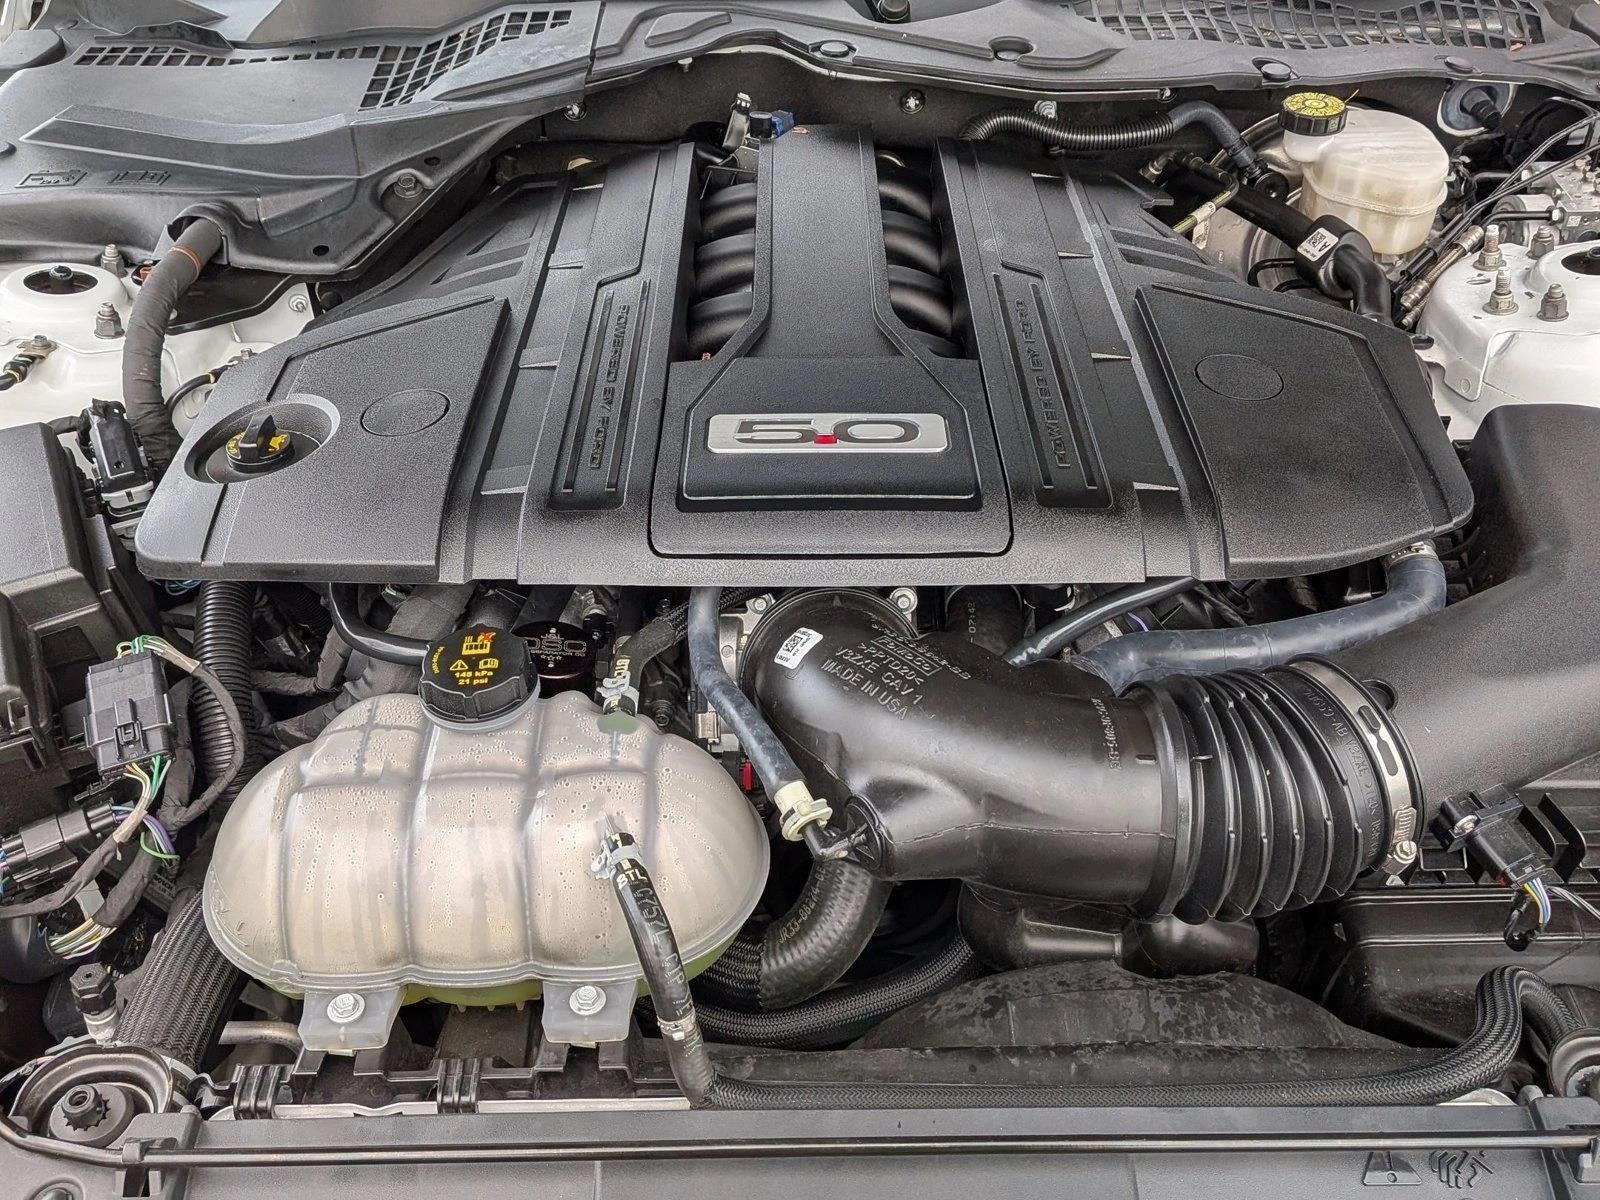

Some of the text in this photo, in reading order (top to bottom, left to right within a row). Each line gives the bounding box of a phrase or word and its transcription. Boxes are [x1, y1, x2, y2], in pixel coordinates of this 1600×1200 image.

[589, 304, 630, 470] POWERED BY FORD
[1015, 298, 1071, 467] POWERED BY FORD
[734, 418, 921, 444] 5.0
[454, 670, 494, 679] 145 kPa
[473, 677, 489, 686] psi
[881, 671, 914, 696] CAV
[821, 658, 909, 720] MADE IN USA
